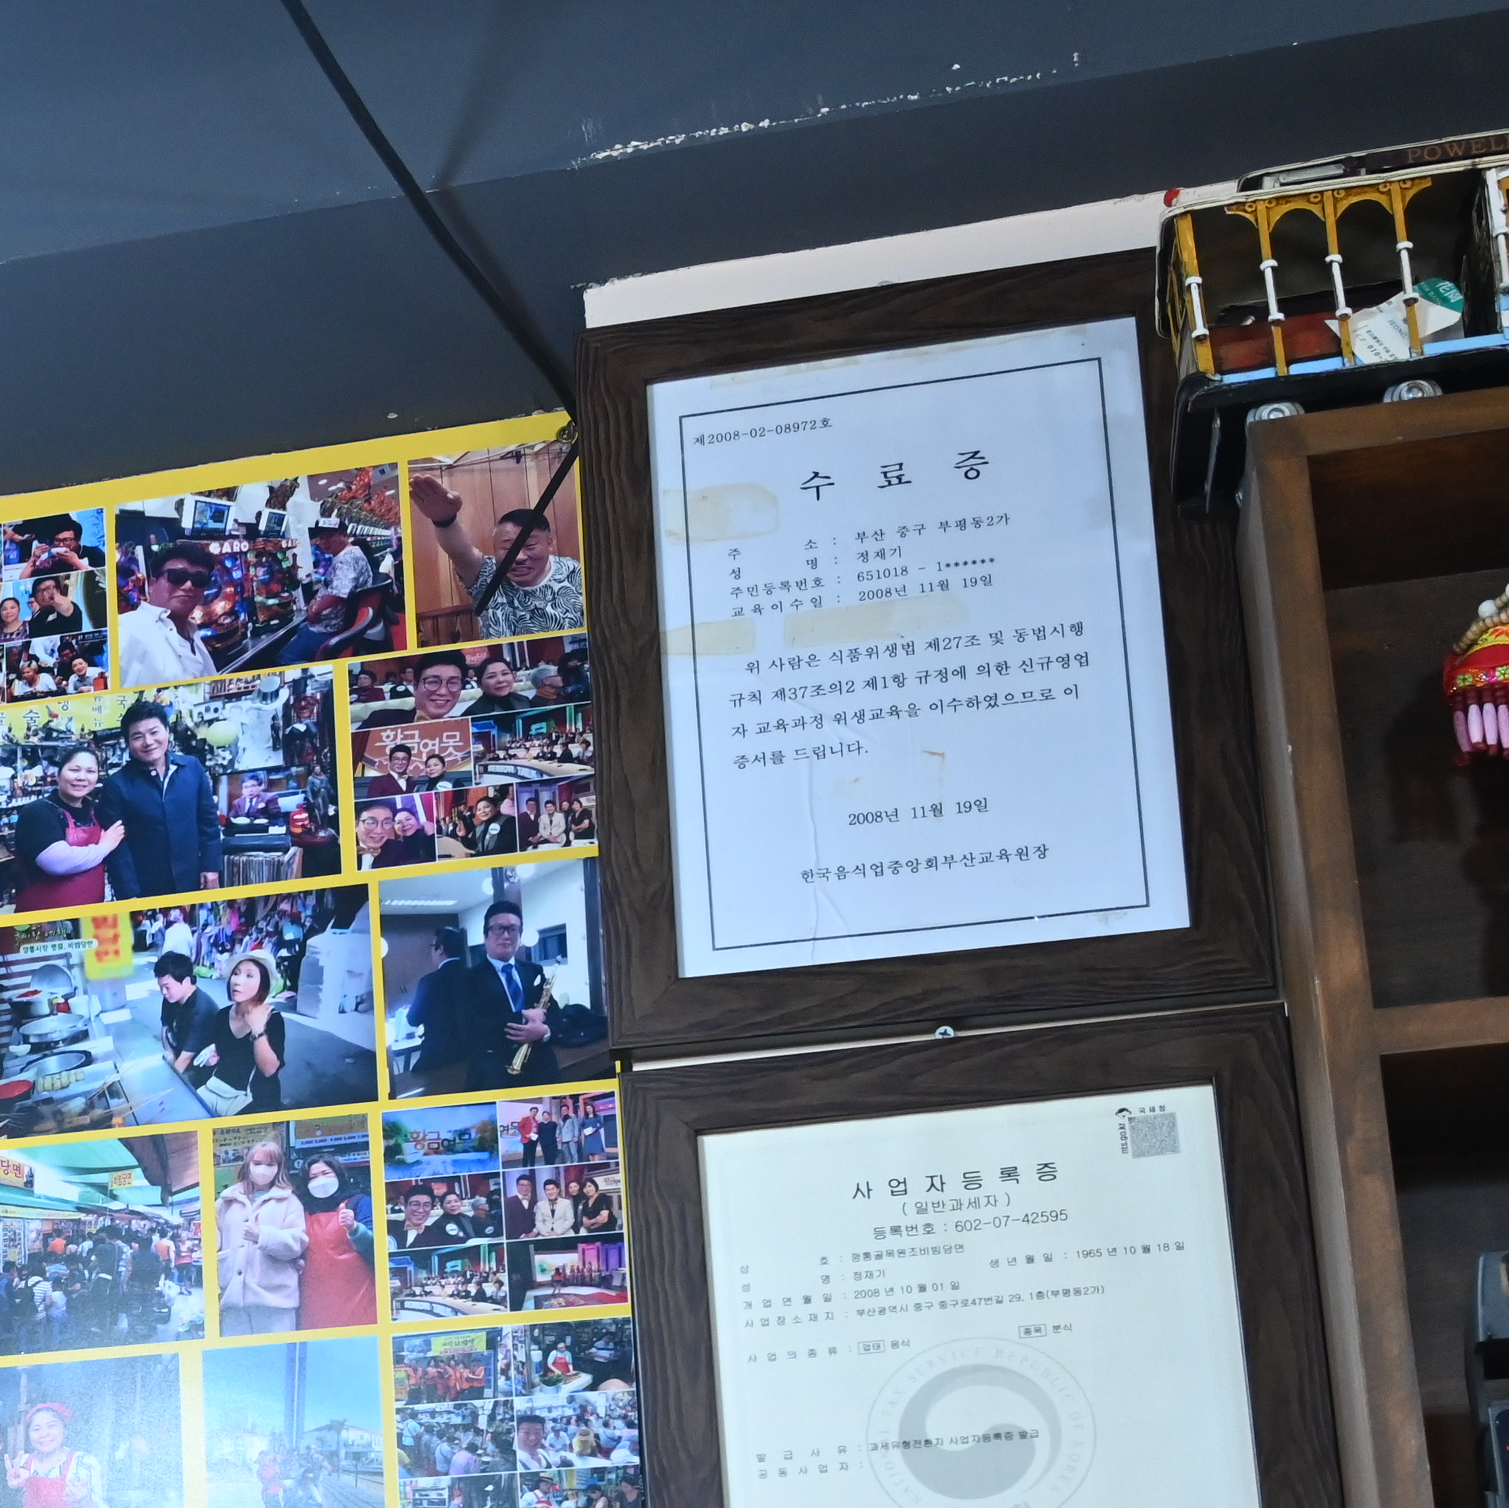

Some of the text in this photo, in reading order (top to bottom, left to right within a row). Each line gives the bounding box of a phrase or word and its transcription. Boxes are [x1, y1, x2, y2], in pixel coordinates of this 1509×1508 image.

[1407, 134, 1509, 164] POWEL
[693, 417, 832, 446] 제2008-02-08972호
[855, 513, 1010, 544] 부산 중구 부평동2가
[857, 546, 901, 563] 정재기
[730, 566, 908, 599] 주민등록번호 651018
[859, 584, 907, 601] 2008년
[920, 579, 949, 593] 11월
[963, 574, 993, 588] 19일
[745, 621, 1083, 675] 위 사람은 식품위생법 제27조 및 동법시행
[729, 651, 1089, 708] 규칙 제37조의2 제1항 규정에 의한 신규영업
[732, 684, 1078, 738] 자 교육과정 위생교육을 이수하였으므로 이
[734, 740, 868, 769] 증서를 드립니다.
[848, 797, 988, 826] 2008년 11월 19일
[801, 843, 1049, 883] 한국음식업중앙회부산교육원장
[1119, 1122, 1130, 1154] nts.go.kr
[852, 1162, 1058, 1207] 사업자등록증
[873, 1209, 1068, 1240] 등록번호 602-07-42595
[1077, 1248, 1103, 1259] 1965
[853, 1269, 885, 1281] 정재기
[853, 1288, 880, 1299] 2008
[856, 1304, 908, 1317] 부산광역시
[913, 1302, 934, 1312] 중구
